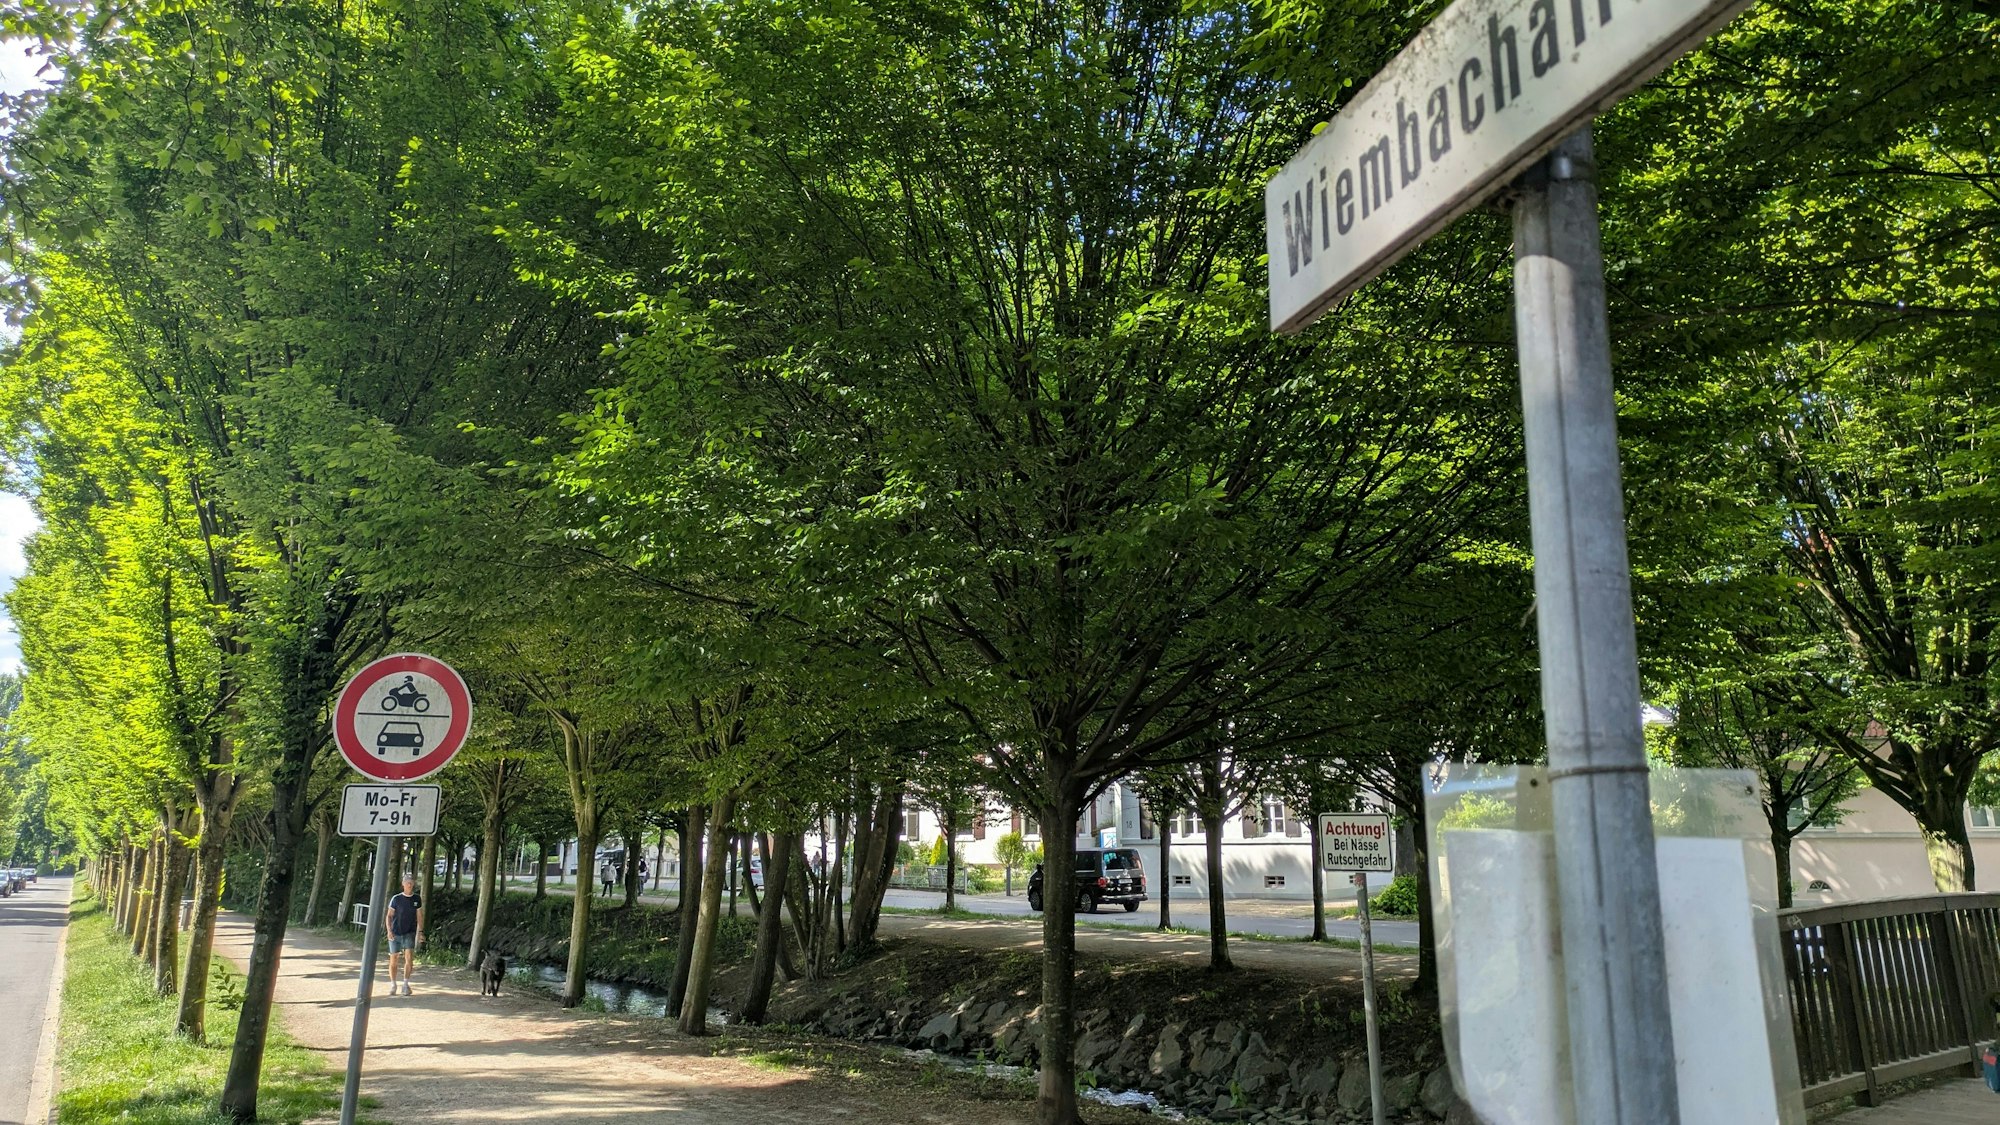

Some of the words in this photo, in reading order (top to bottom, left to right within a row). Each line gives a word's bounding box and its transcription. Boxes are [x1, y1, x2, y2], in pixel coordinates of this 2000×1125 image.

[1282, 0, 1611, 278] Wiembacha
[365, 792, 417, 806] Mo-Fr
[1325, 821, 1386, 839] Achtung!
[1334, 838, 1349, 851] Bei
[1351, 838, 1379, 851] Nässe
[1327, 853, 1387, 869] Rutschgefahr
